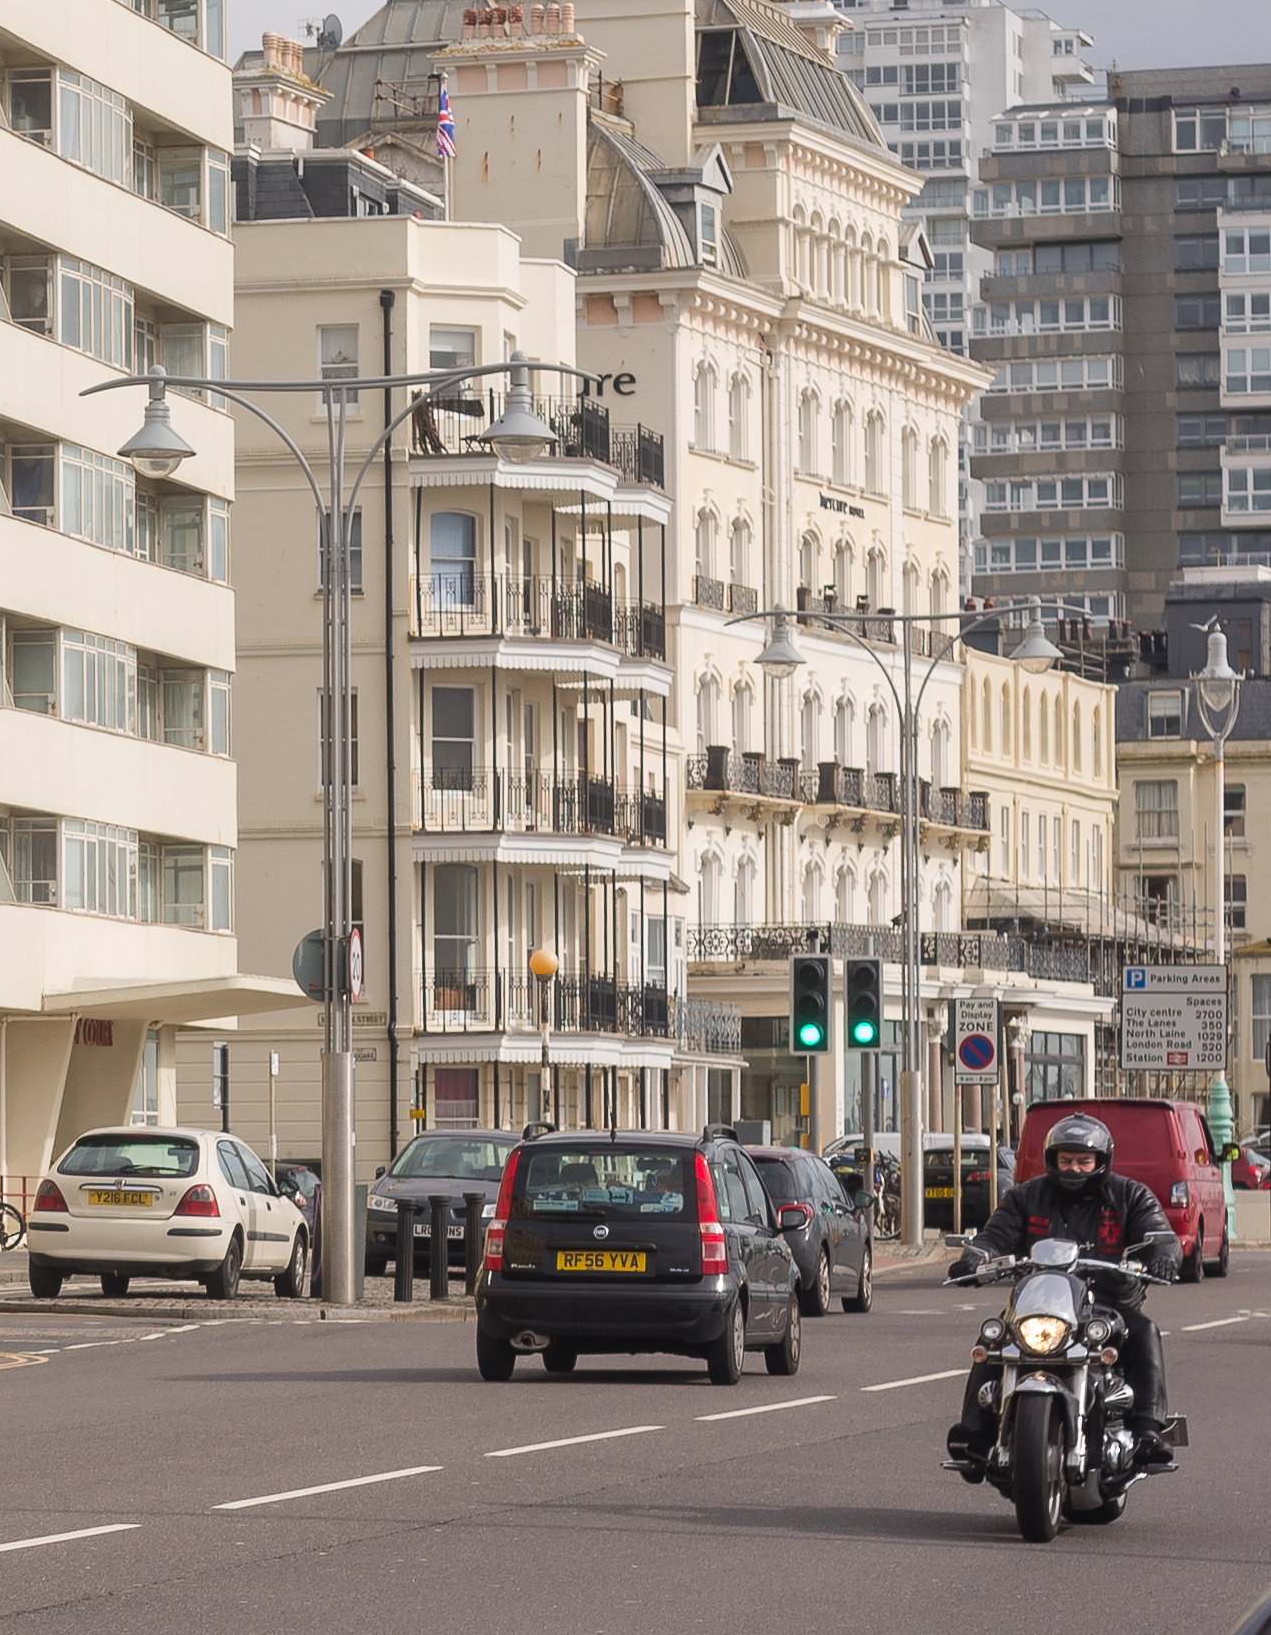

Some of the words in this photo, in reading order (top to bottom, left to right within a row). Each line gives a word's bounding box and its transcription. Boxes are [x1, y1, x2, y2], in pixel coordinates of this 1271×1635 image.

[1150, 974, 1188, 984] Parking
[1192, 974, 1221, 983] Areas
[960, 1001, 975, 1010] Pay
[1186, 997, 1222, 1007] Spaces
[961, 1011, 993, 1020] Display
[1126, 1008, 1147, 1018] City
[1150, 1008, 1183, 1016] centre
[1196, 1010, 1223, 1019] 2700
[959, 1022, 994, 1032] ZONE
[1126, 1019, 1144, 1027] The
[1148, 1019, 1177, 1027] Lanes
[1201, 1021, 1223, 1030] 350
[1126, 1029, 1156, 1038] North
[1159, 1029, 1186, 1038] Laine
[1197, 1032, 1223, 1041] 1029
[1126, 1040, 1163, 1049] London
[1166, 1040, 1192, 1049] Road
[1202, 1043, 1223, 1051] 520
[1126, 1053, 1163, 1062] Station
[1197, 1053, 1223, 1062] 1200
[96, 1192, 121, 1203] Y216
[123, 1194, 146, 1204] FCL
[564, 1253, 604, 1267] RF56
[609, 1253, 639, 1268] YVA
